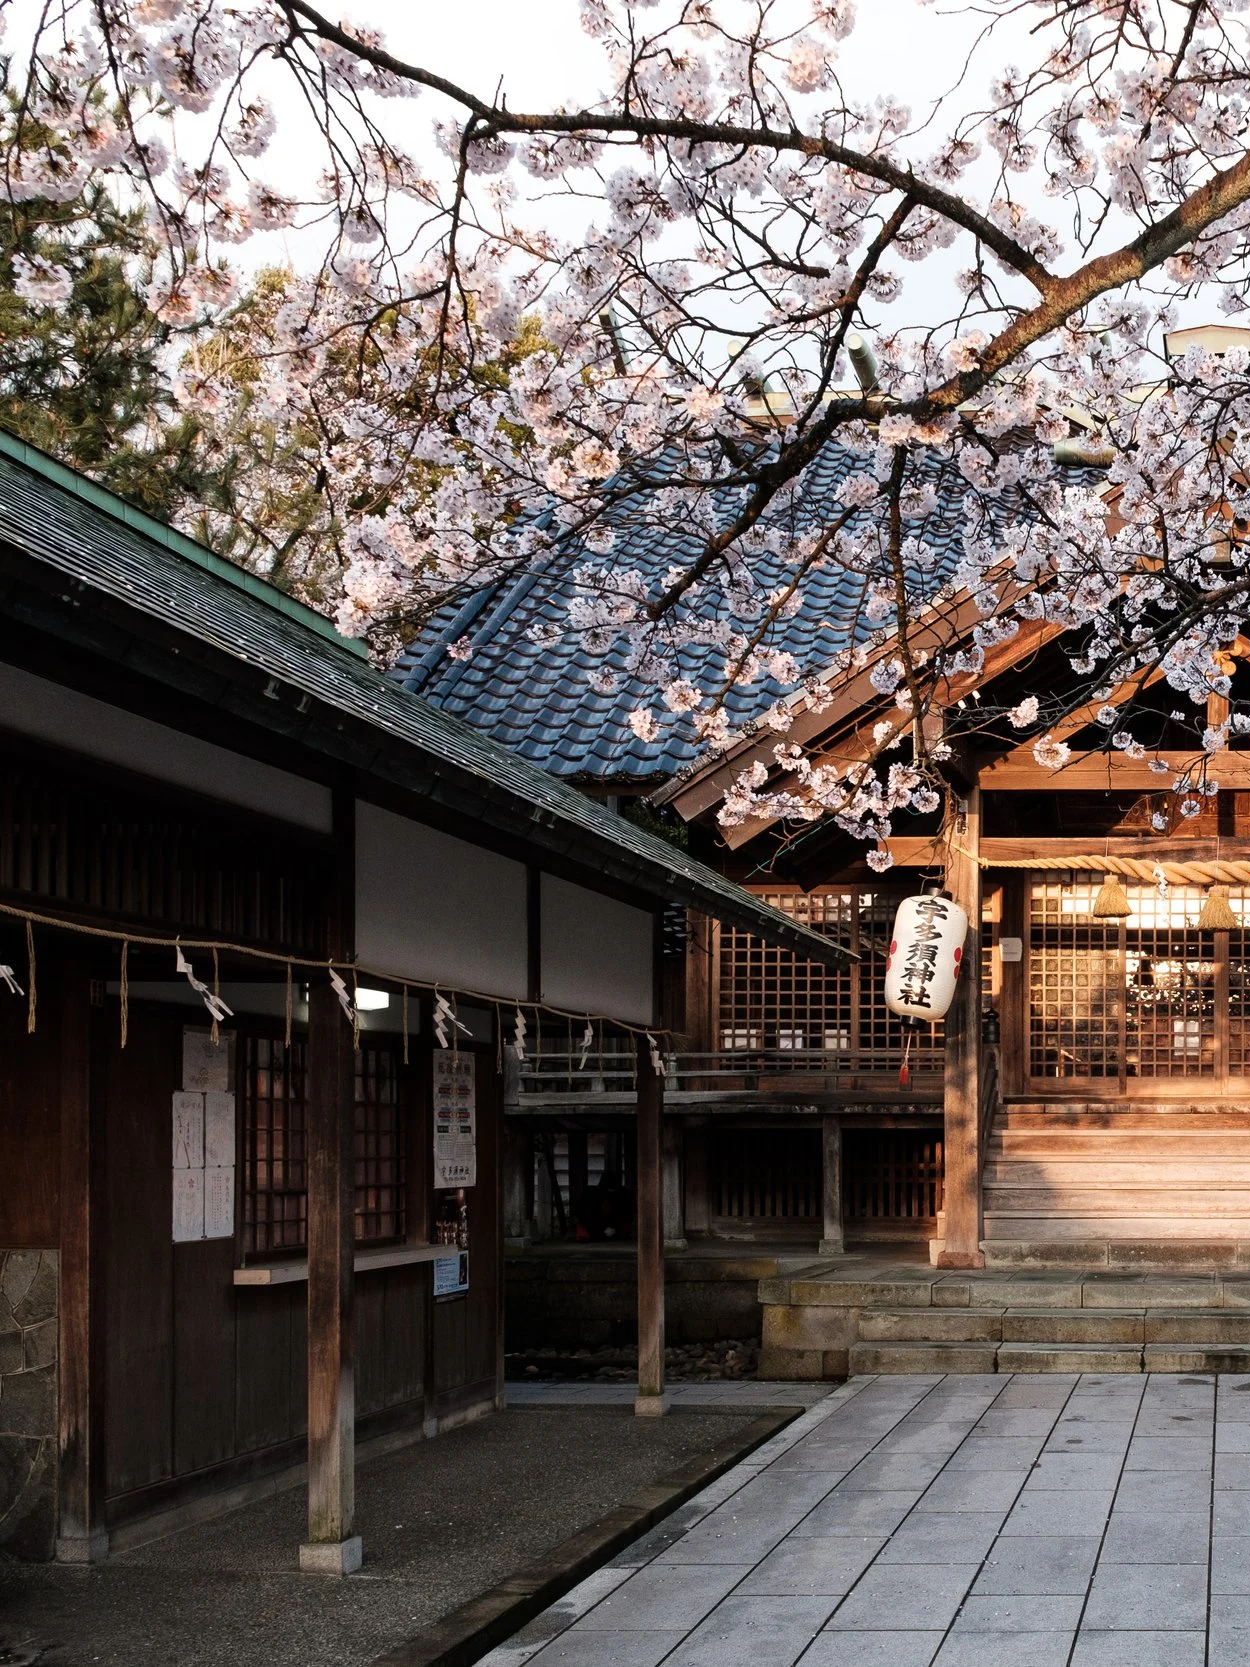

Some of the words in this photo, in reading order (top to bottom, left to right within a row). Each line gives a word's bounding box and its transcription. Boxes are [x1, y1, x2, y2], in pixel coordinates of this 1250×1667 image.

[898, 899, 949, 1008] 宇多須神社
